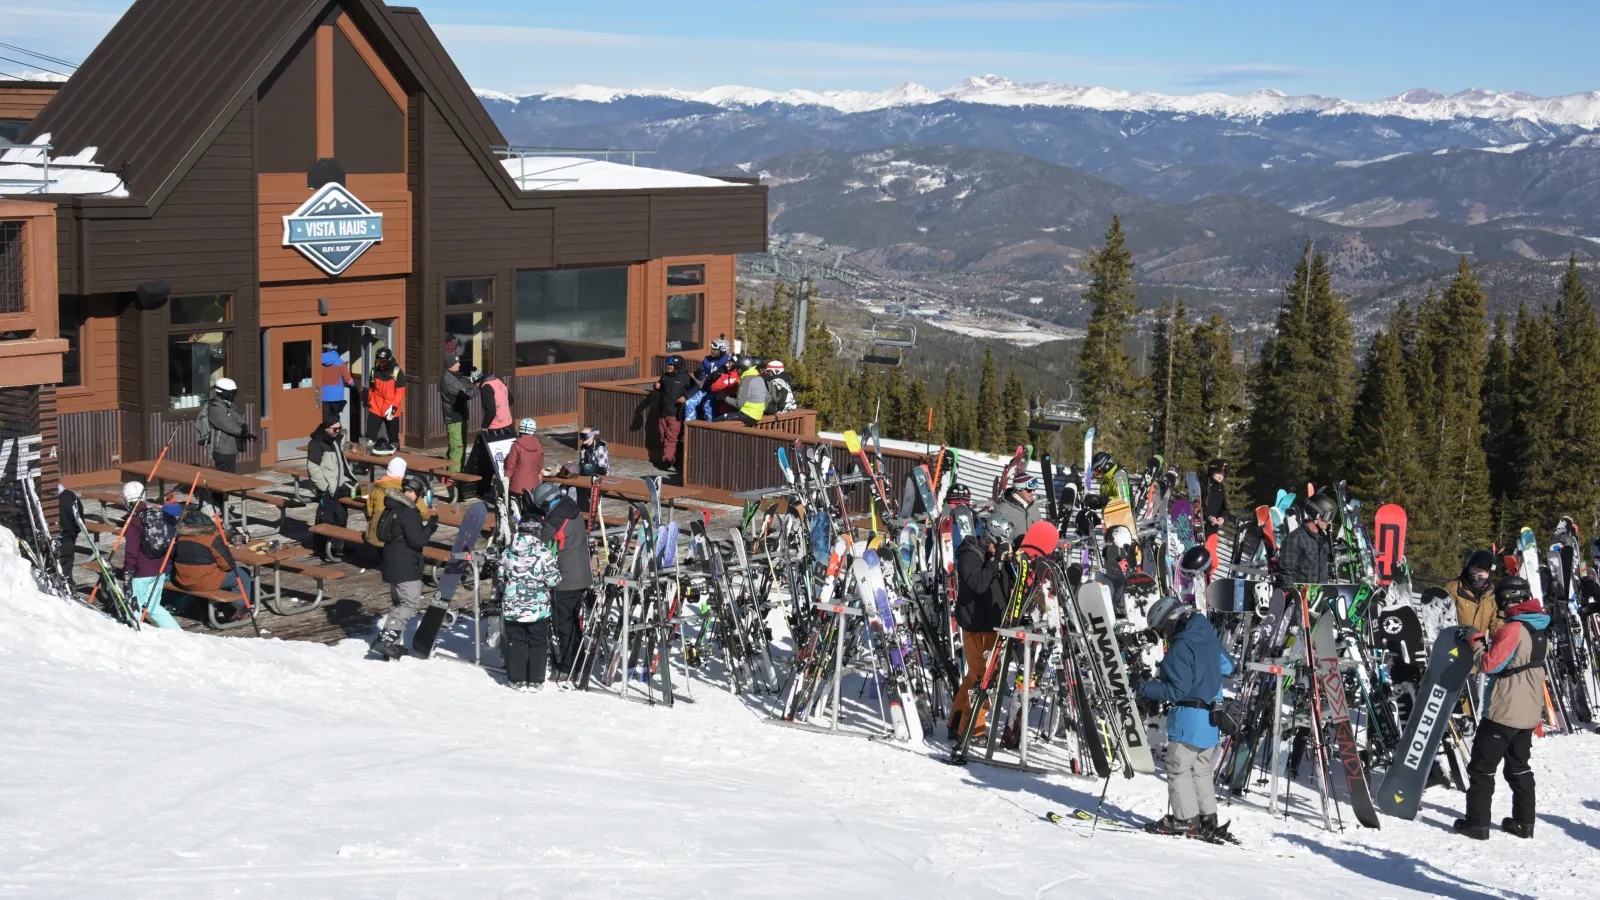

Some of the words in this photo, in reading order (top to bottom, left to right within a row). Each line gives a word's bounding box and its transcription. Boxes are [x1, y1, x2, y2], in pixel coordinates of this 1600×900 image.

[305, 221, 336, 236] VISTA
[339, 220, 366, 235] HAUS
[1014, 560, 1028, 618] BLIZZARD
[1320, 657, 1364, 792] ROSSIGNOL
[1406, 688, 1445, 767] BURTON
